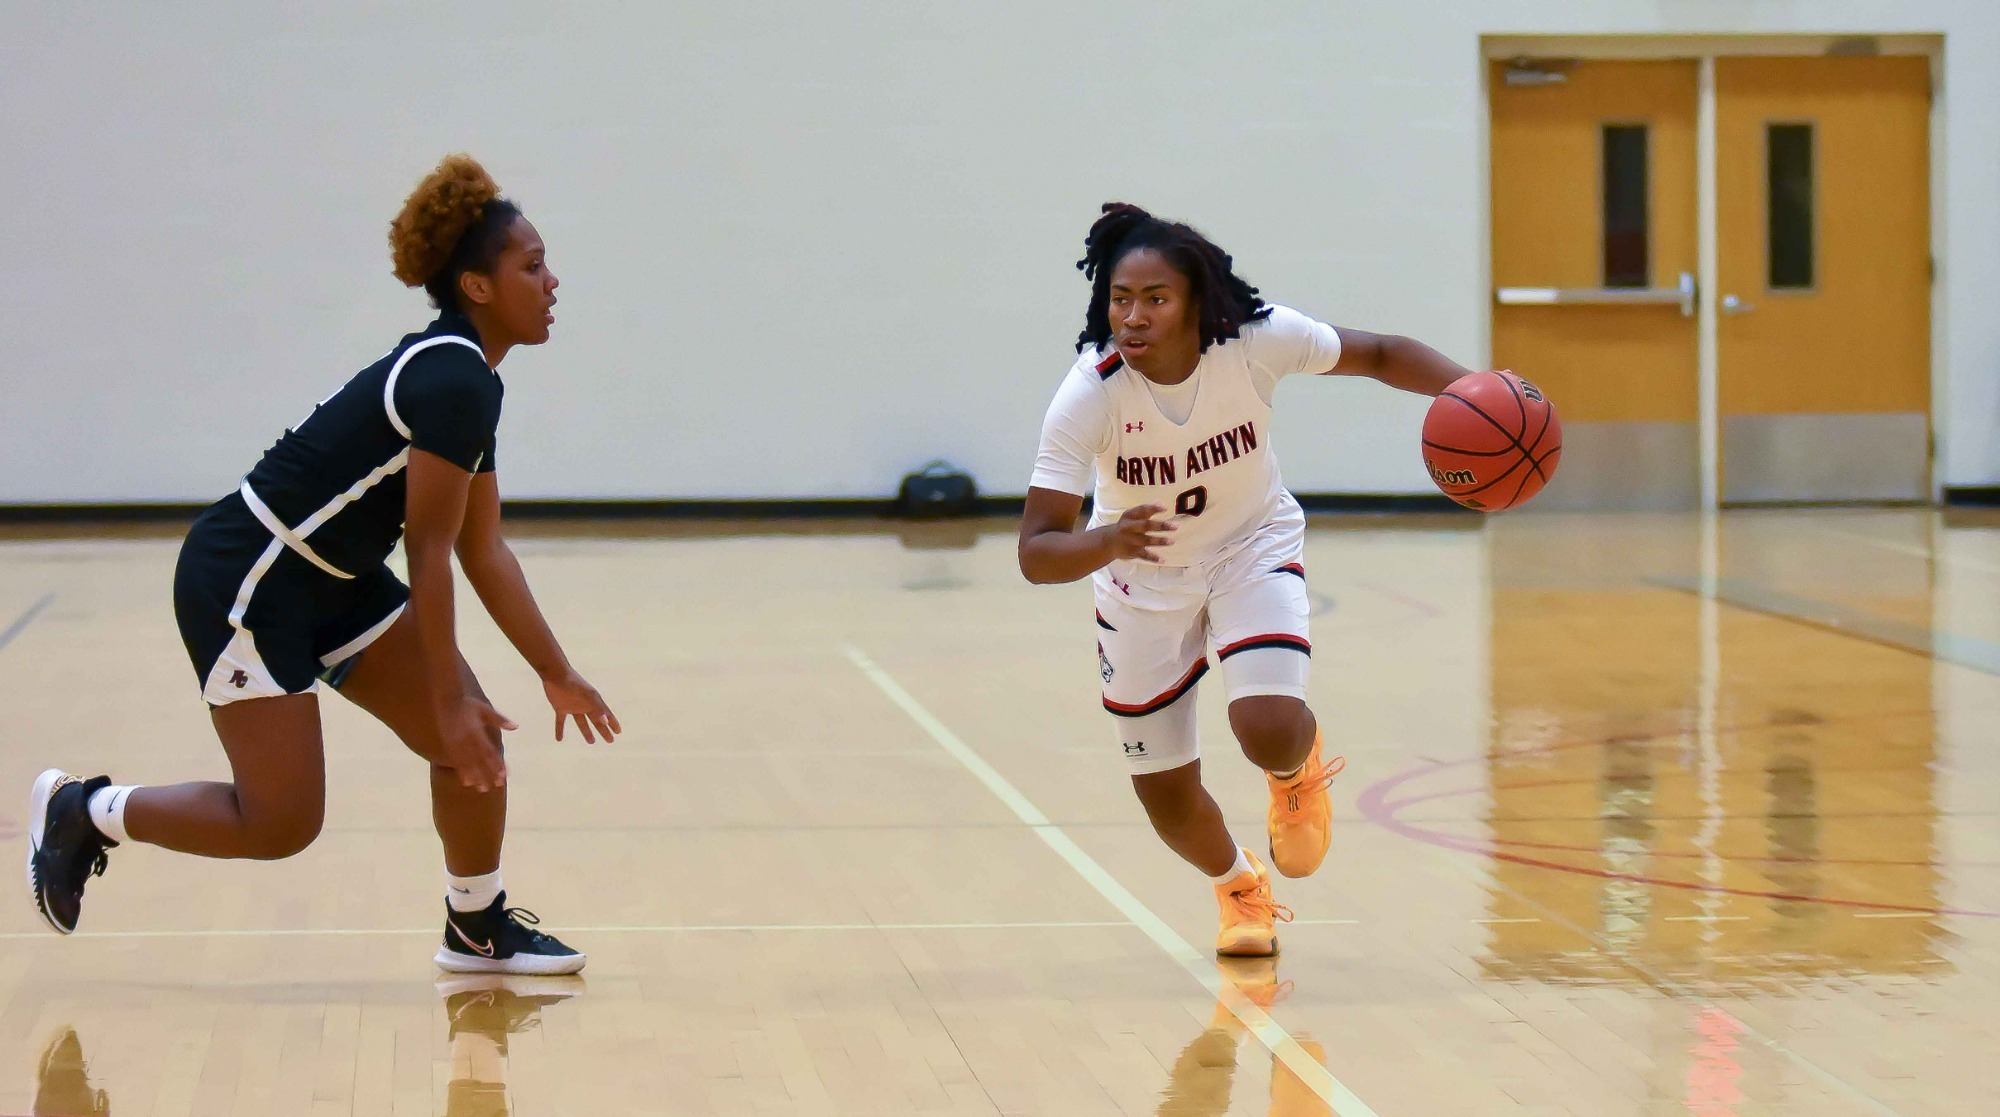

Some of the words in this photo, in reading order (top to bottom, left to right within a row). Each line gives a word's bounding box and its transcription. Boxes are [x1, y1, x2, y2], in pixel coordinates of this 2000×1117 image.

[1116, 454, 1176, 486] BRYN
[1186, 420, 1258, 480] ATHYN
[1428, 459, 1478, 485] lson
[1175, 485, 1208, 517] 0
